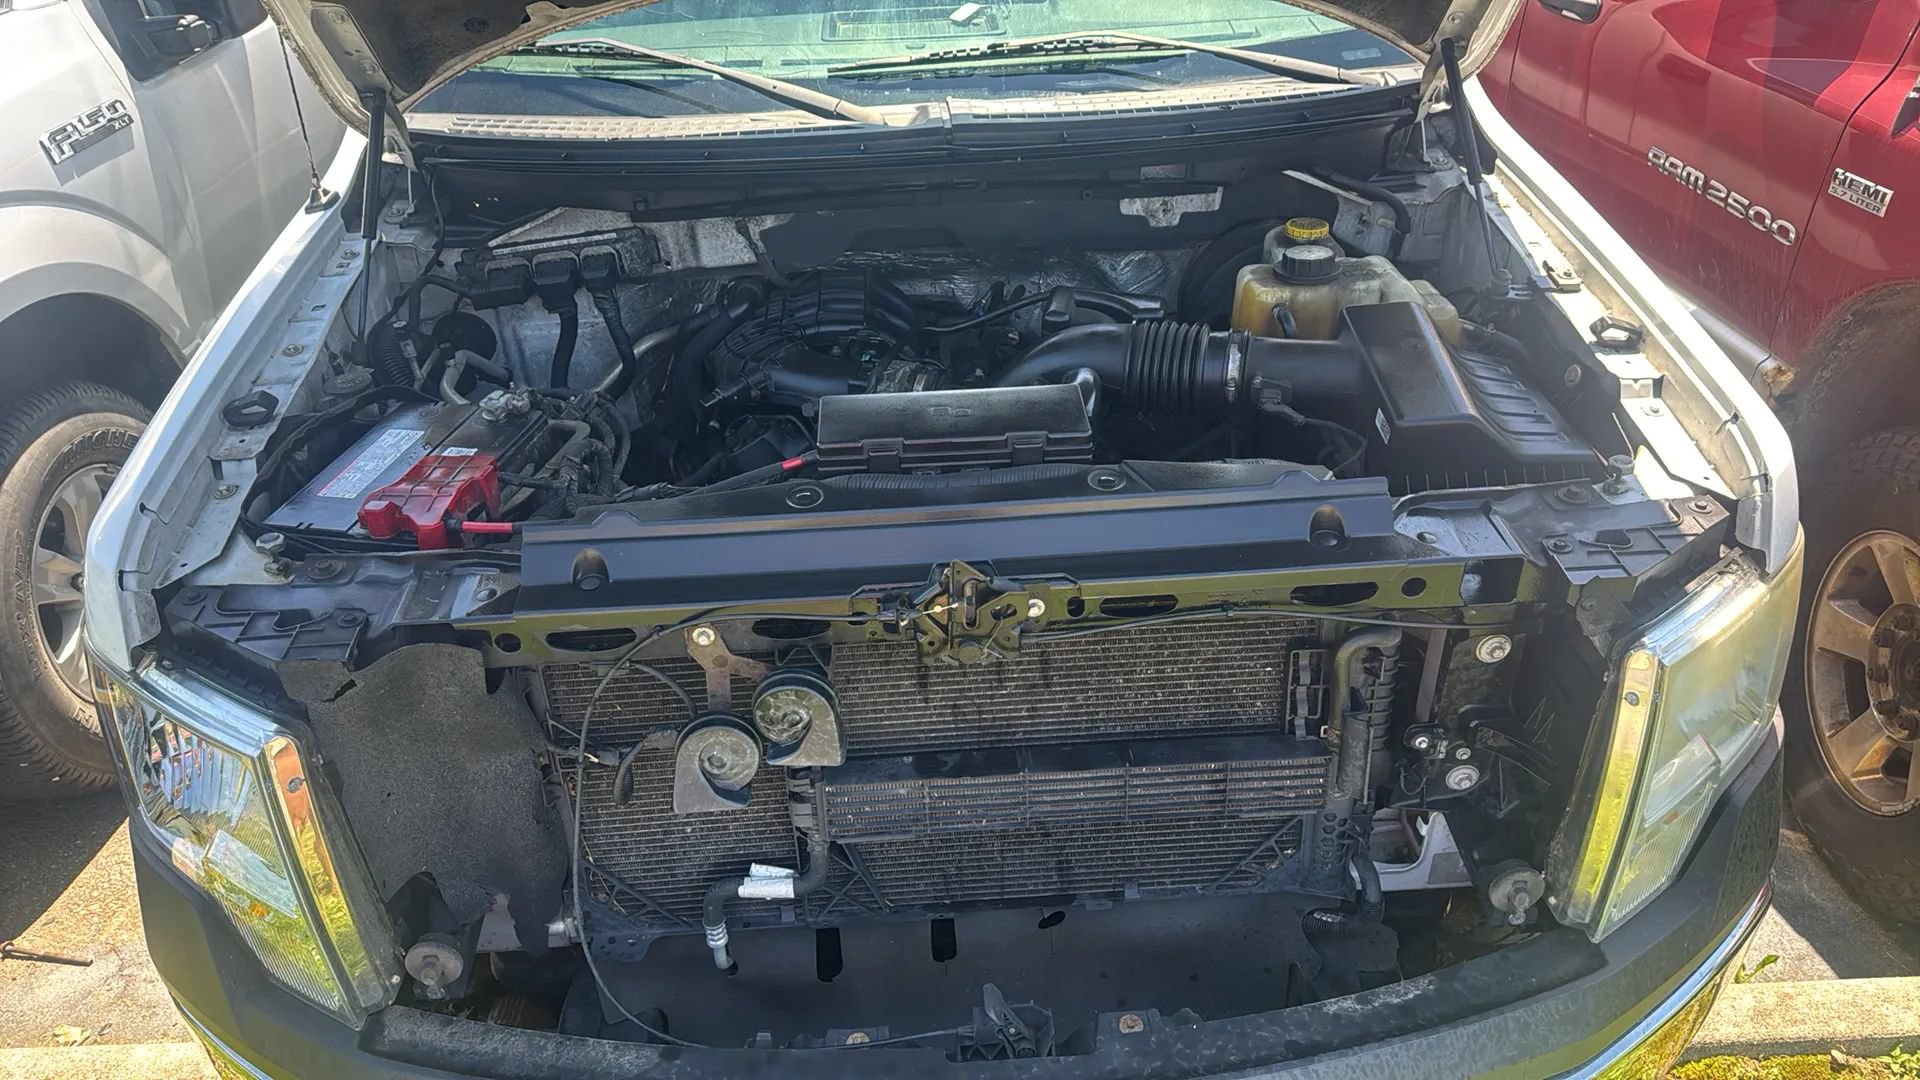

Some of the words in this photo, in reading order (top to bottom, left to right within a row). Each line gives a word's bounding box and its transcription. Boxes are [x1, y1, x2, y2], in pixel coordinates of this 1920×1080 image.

[112, 115, 131, 130] XLT
[1647, 145, 1706, 194] RAM
[1706, 179, 1797, 246] 2500
[1829, 186, 1848, 198] 5.7
[1849, 194, 1881, 214] LITER
[1832, 169, 1889, 204] HEMI
[63, 428, 140, 470] MICHE
